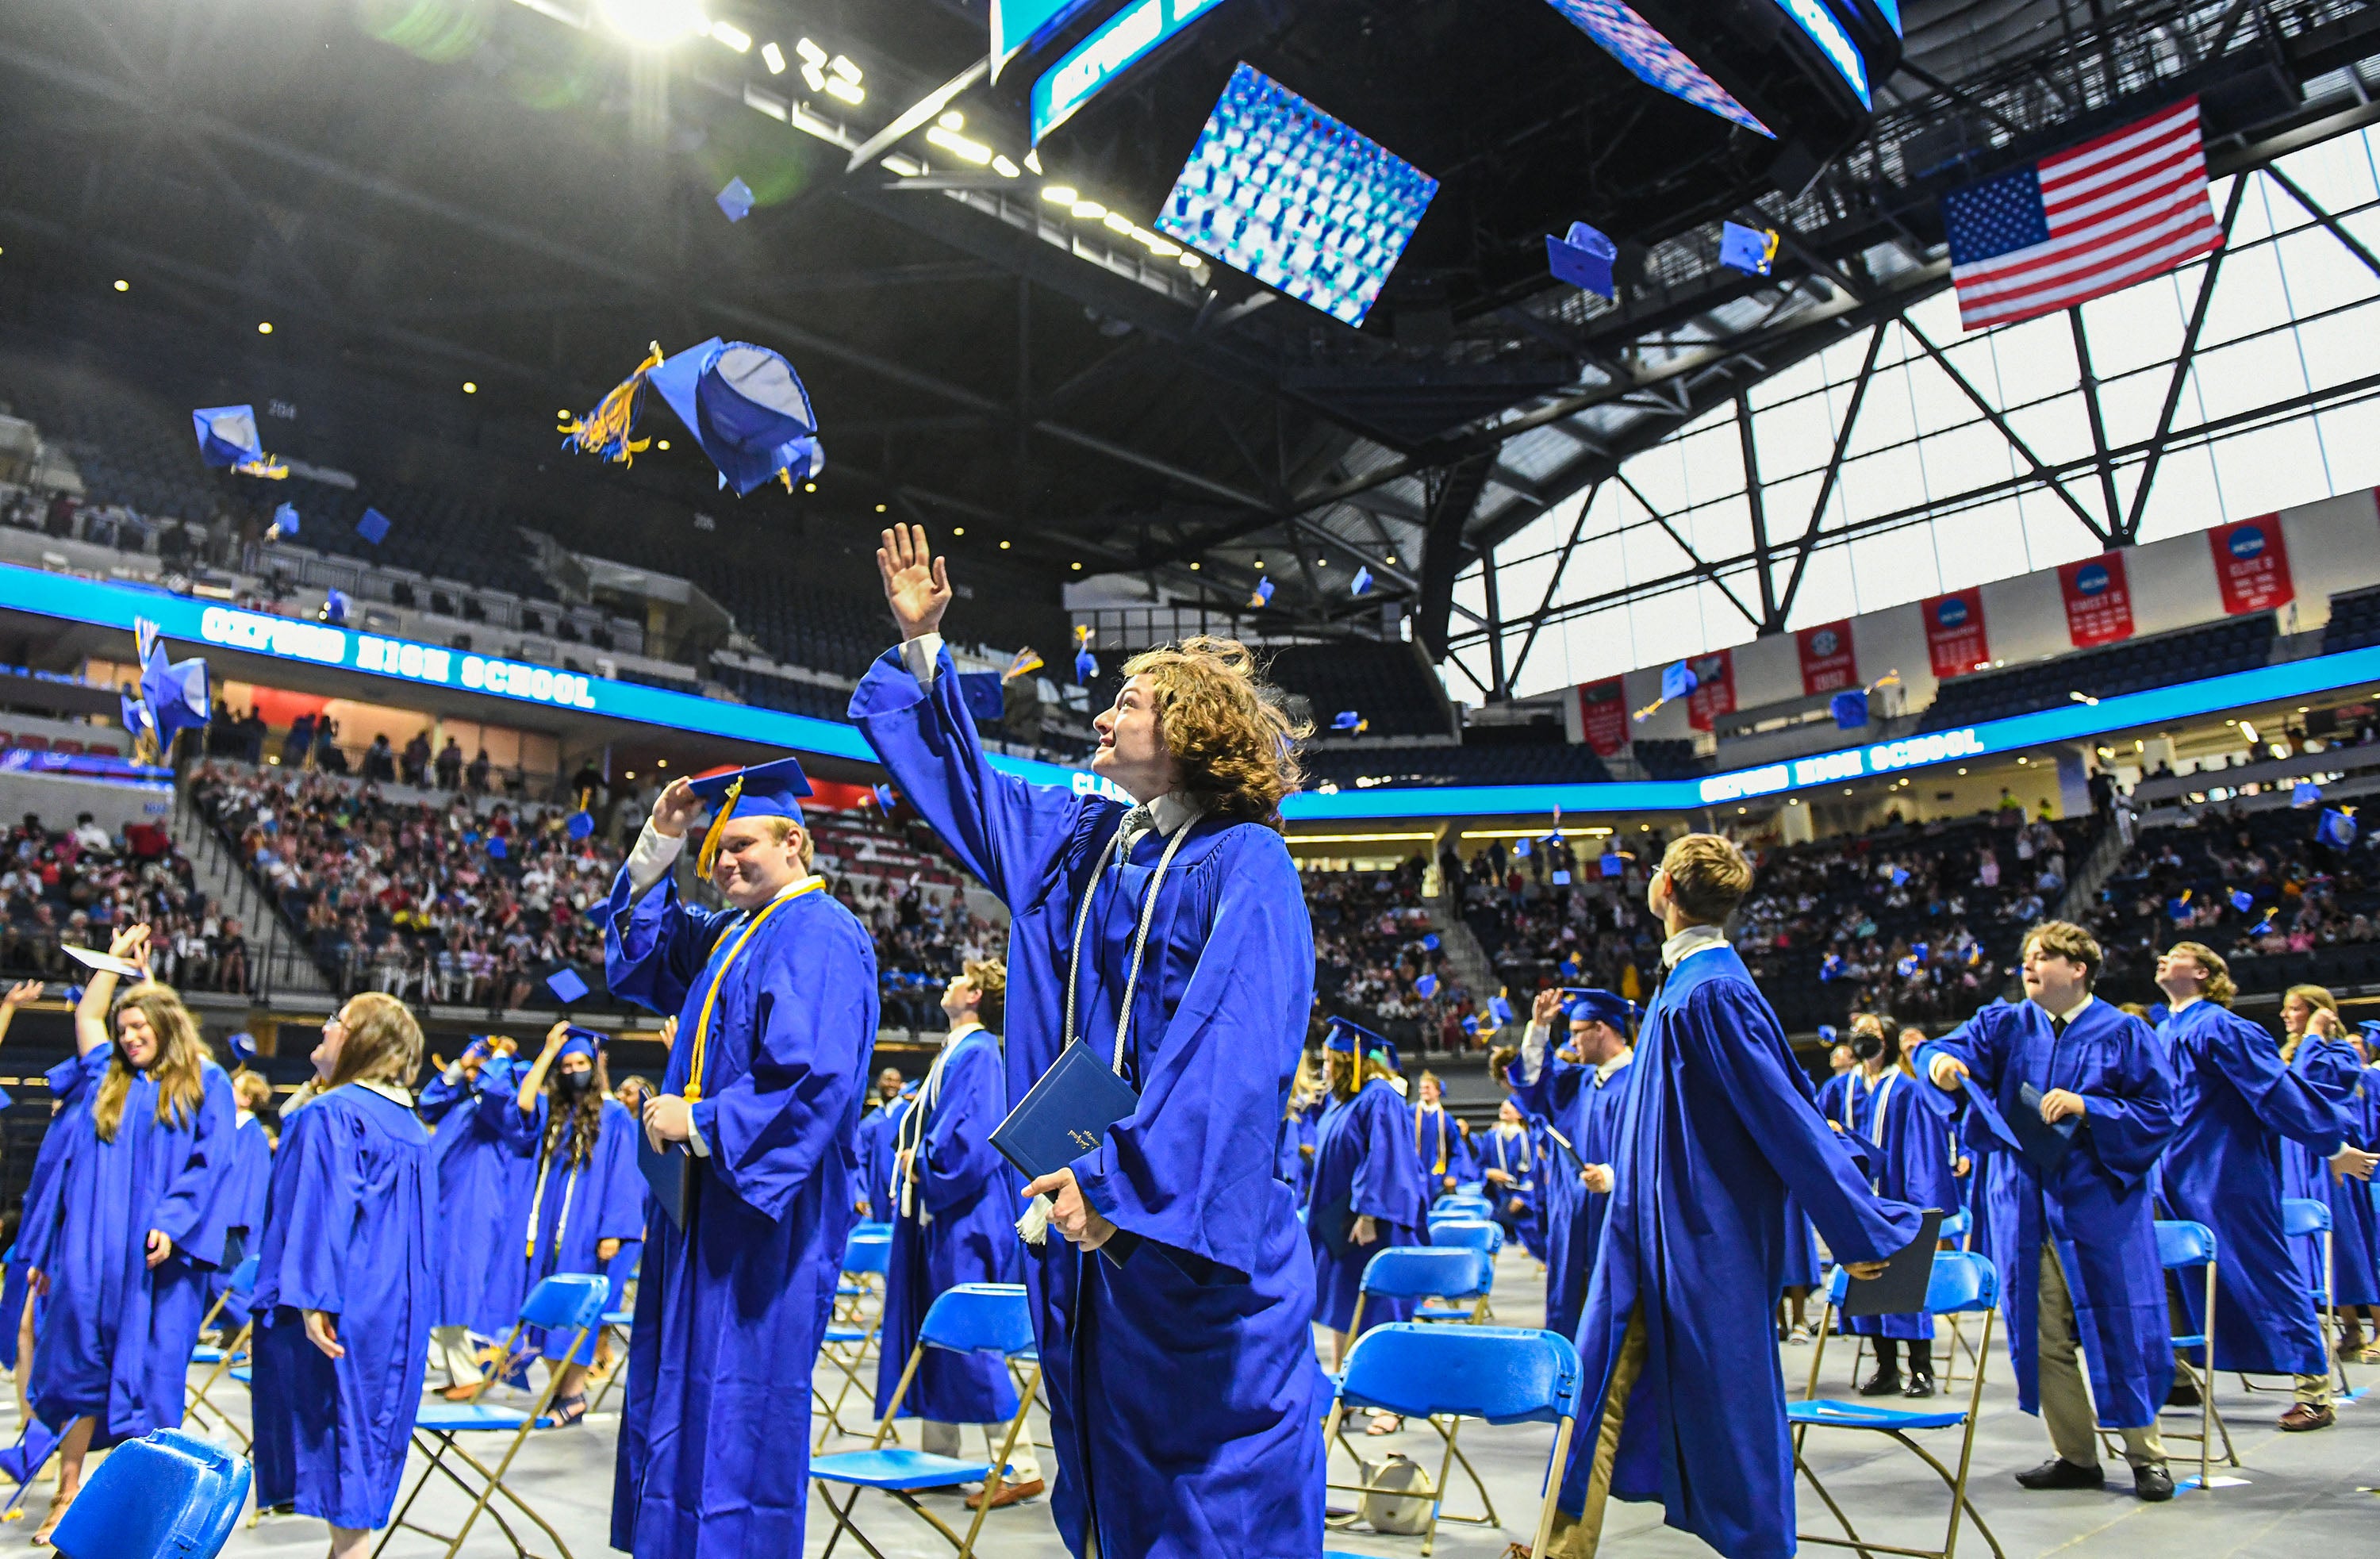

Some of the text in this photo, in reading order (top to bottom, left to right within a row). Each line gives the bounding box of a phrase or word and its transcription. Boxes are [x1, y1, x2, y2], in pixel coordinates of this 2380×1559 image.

[202, 607, 595, 708] OXFORD HIGH SCHOOL
[1870, 728, 1984, 771] SCHOOL
